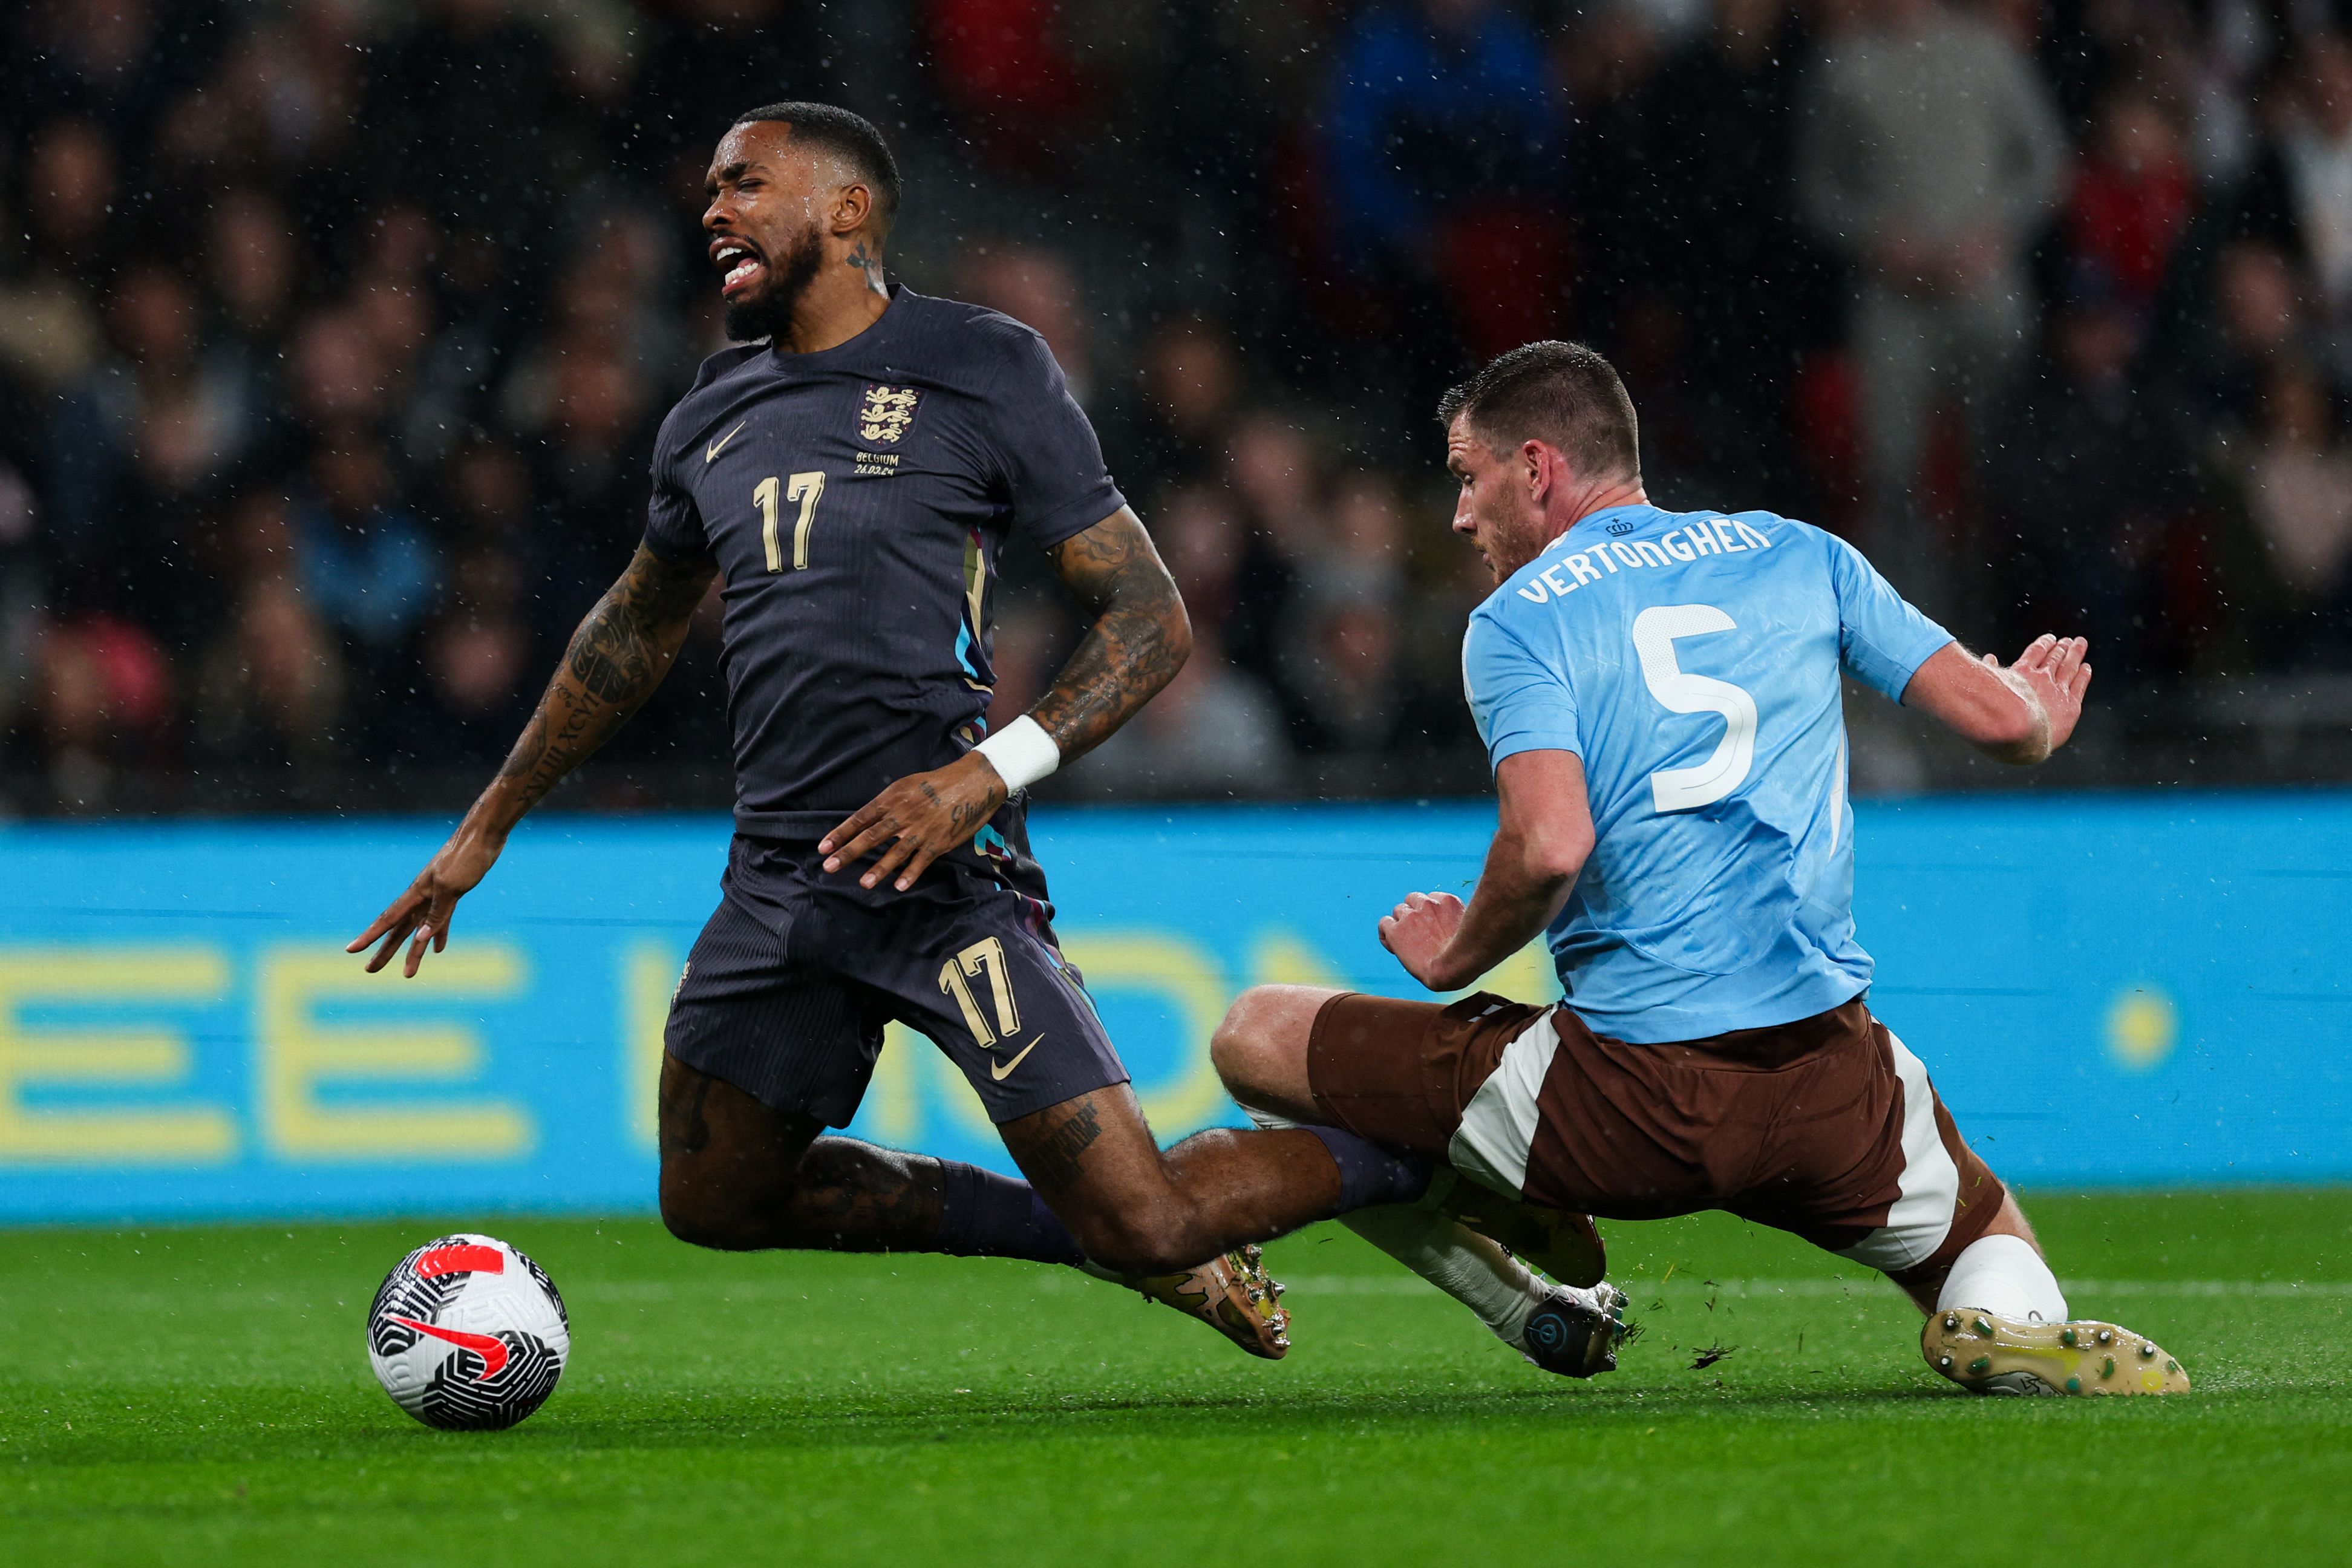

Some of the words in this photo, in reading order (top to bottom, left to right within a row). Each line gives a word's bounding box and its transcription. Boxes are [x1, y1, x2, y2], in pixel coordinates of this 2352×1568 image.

[854, 464, 894, 476] 26.03.24
[856, 452, 899, 466] BELGIUM
[753, 471, 826, 573] 17
[1517, 518, 1772, 604] VERTONGHEN
[1633, 604, 1757, 812] 5
[938, 936, 1021, 1048] 17
